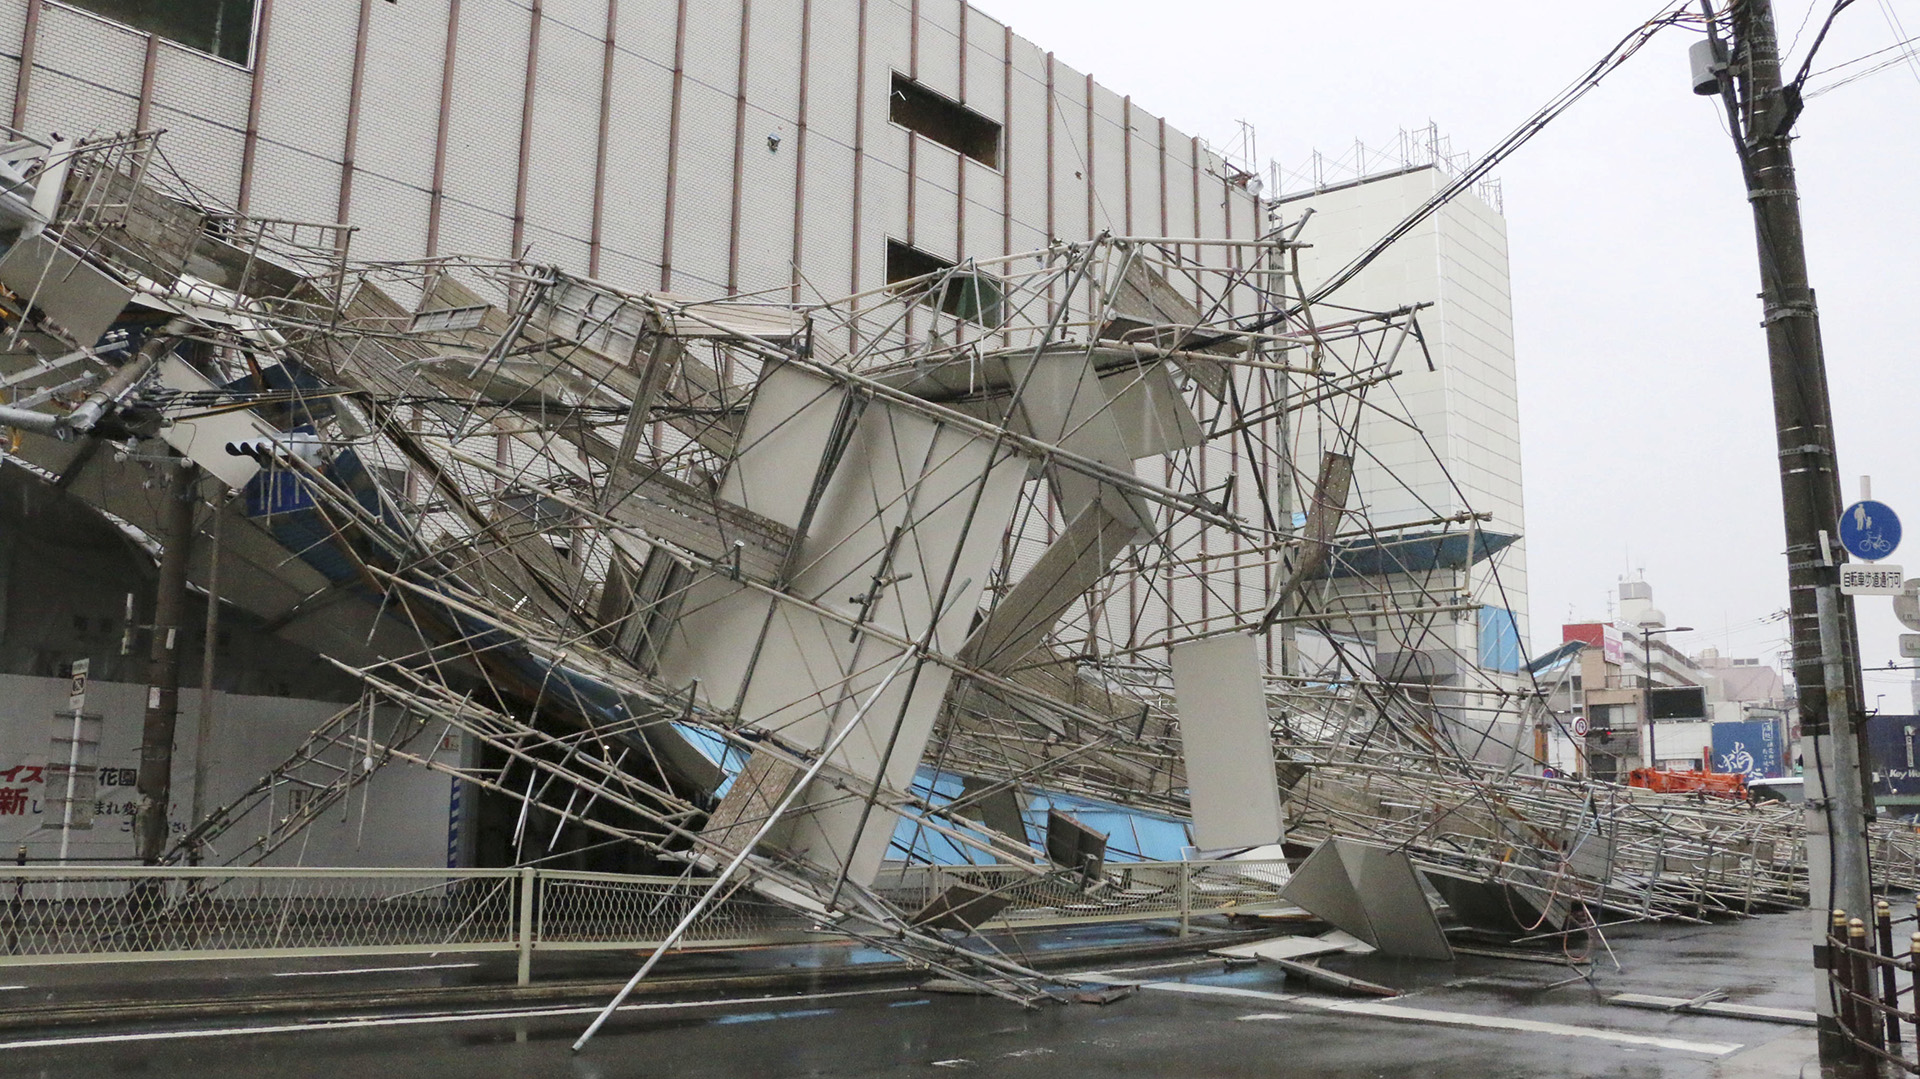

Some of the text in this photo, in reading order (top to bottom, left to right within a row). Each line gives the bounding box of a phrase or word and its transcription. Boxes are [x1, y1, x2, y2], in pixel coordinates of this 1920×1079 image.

[1843, 571, 1902, 589] 自転車歩道通行可
[99, 767, 137, 787] 花園
[1889, 769, 1907, 780] Key
